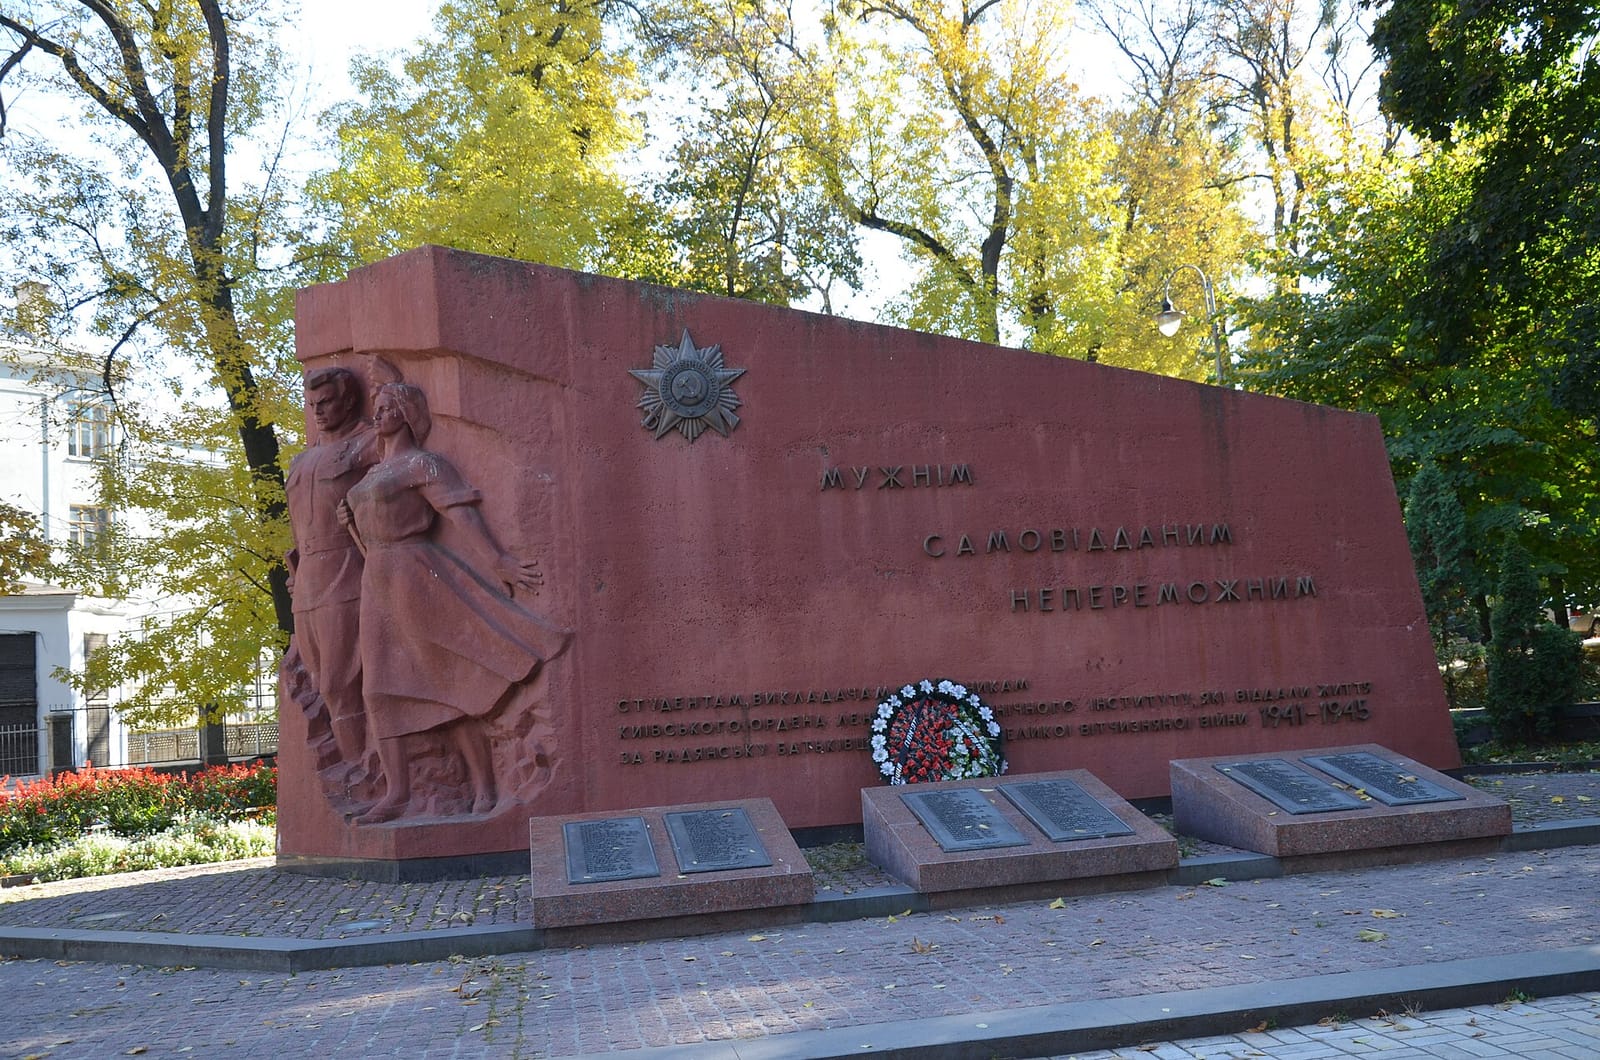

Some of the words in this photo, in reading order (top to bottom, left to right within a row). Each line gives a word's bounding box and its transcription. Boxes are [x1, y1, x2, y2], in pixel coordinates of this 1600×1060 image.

[820, 463, 974, 491] МУЖНІМ
[923, 523, 1233, 557] САМОВІДДАНИМ
[1010, 576, 1317, 612] НЕПЕРЕМОЖНИМ
[617, 693, 749, 713] СТУДЕНТАМ,
[966, 678, 1029, 695] НИКАМ
[751, 714, 826, 733] ОРДЕНА
[837, 712, 874, 729] ЛЕН
[993, 700, 1075, 718] НІЧНОГО
[1200, 689, 1227, 706] ЯКІ
[1235, 686, 1311, 704] ВІДДАЛИ
[1317, 681, 1373, 698] ЖИТТЯ
[620, 750, 643, 765] ЗА
[653, 743, 767, 763] РАДЯНСЬКУ
[1199, 711, 1248, 729] ВІЙНИ
